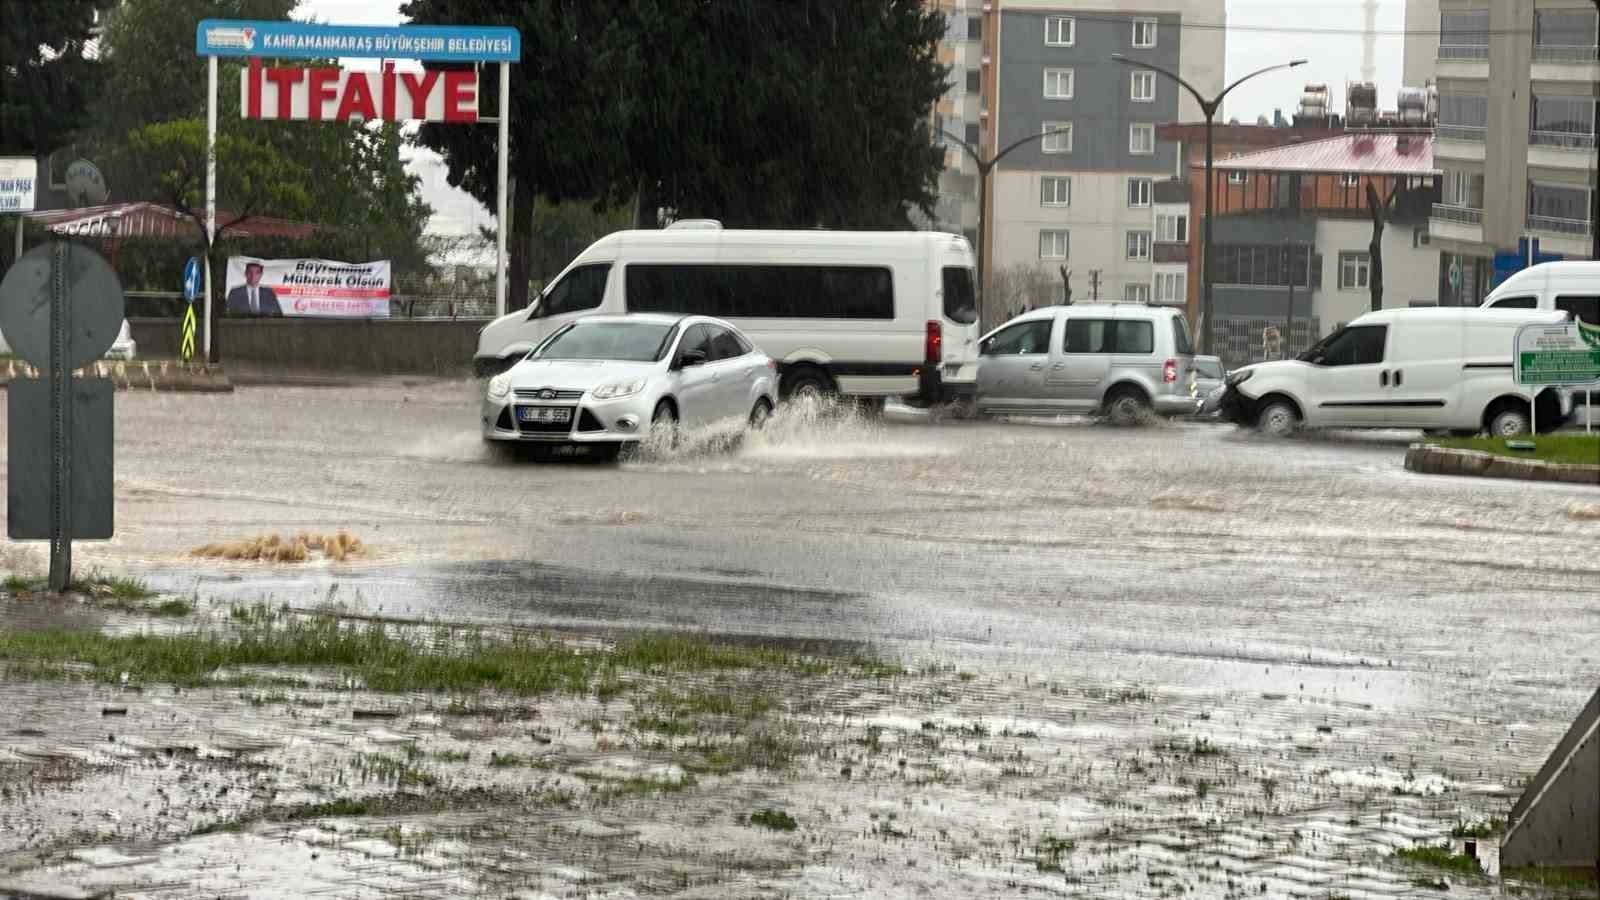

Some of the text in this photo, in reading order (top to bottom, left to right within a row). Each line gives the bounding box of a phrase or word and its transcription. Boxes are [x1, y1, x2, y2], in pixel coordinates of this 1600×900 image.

[263, 33, 373, 52] KAHRAMANMARAŞ
[448, 35, 511, 54] BELEDİYESİ
[248, 57, 477, 121] İTFAİYE
